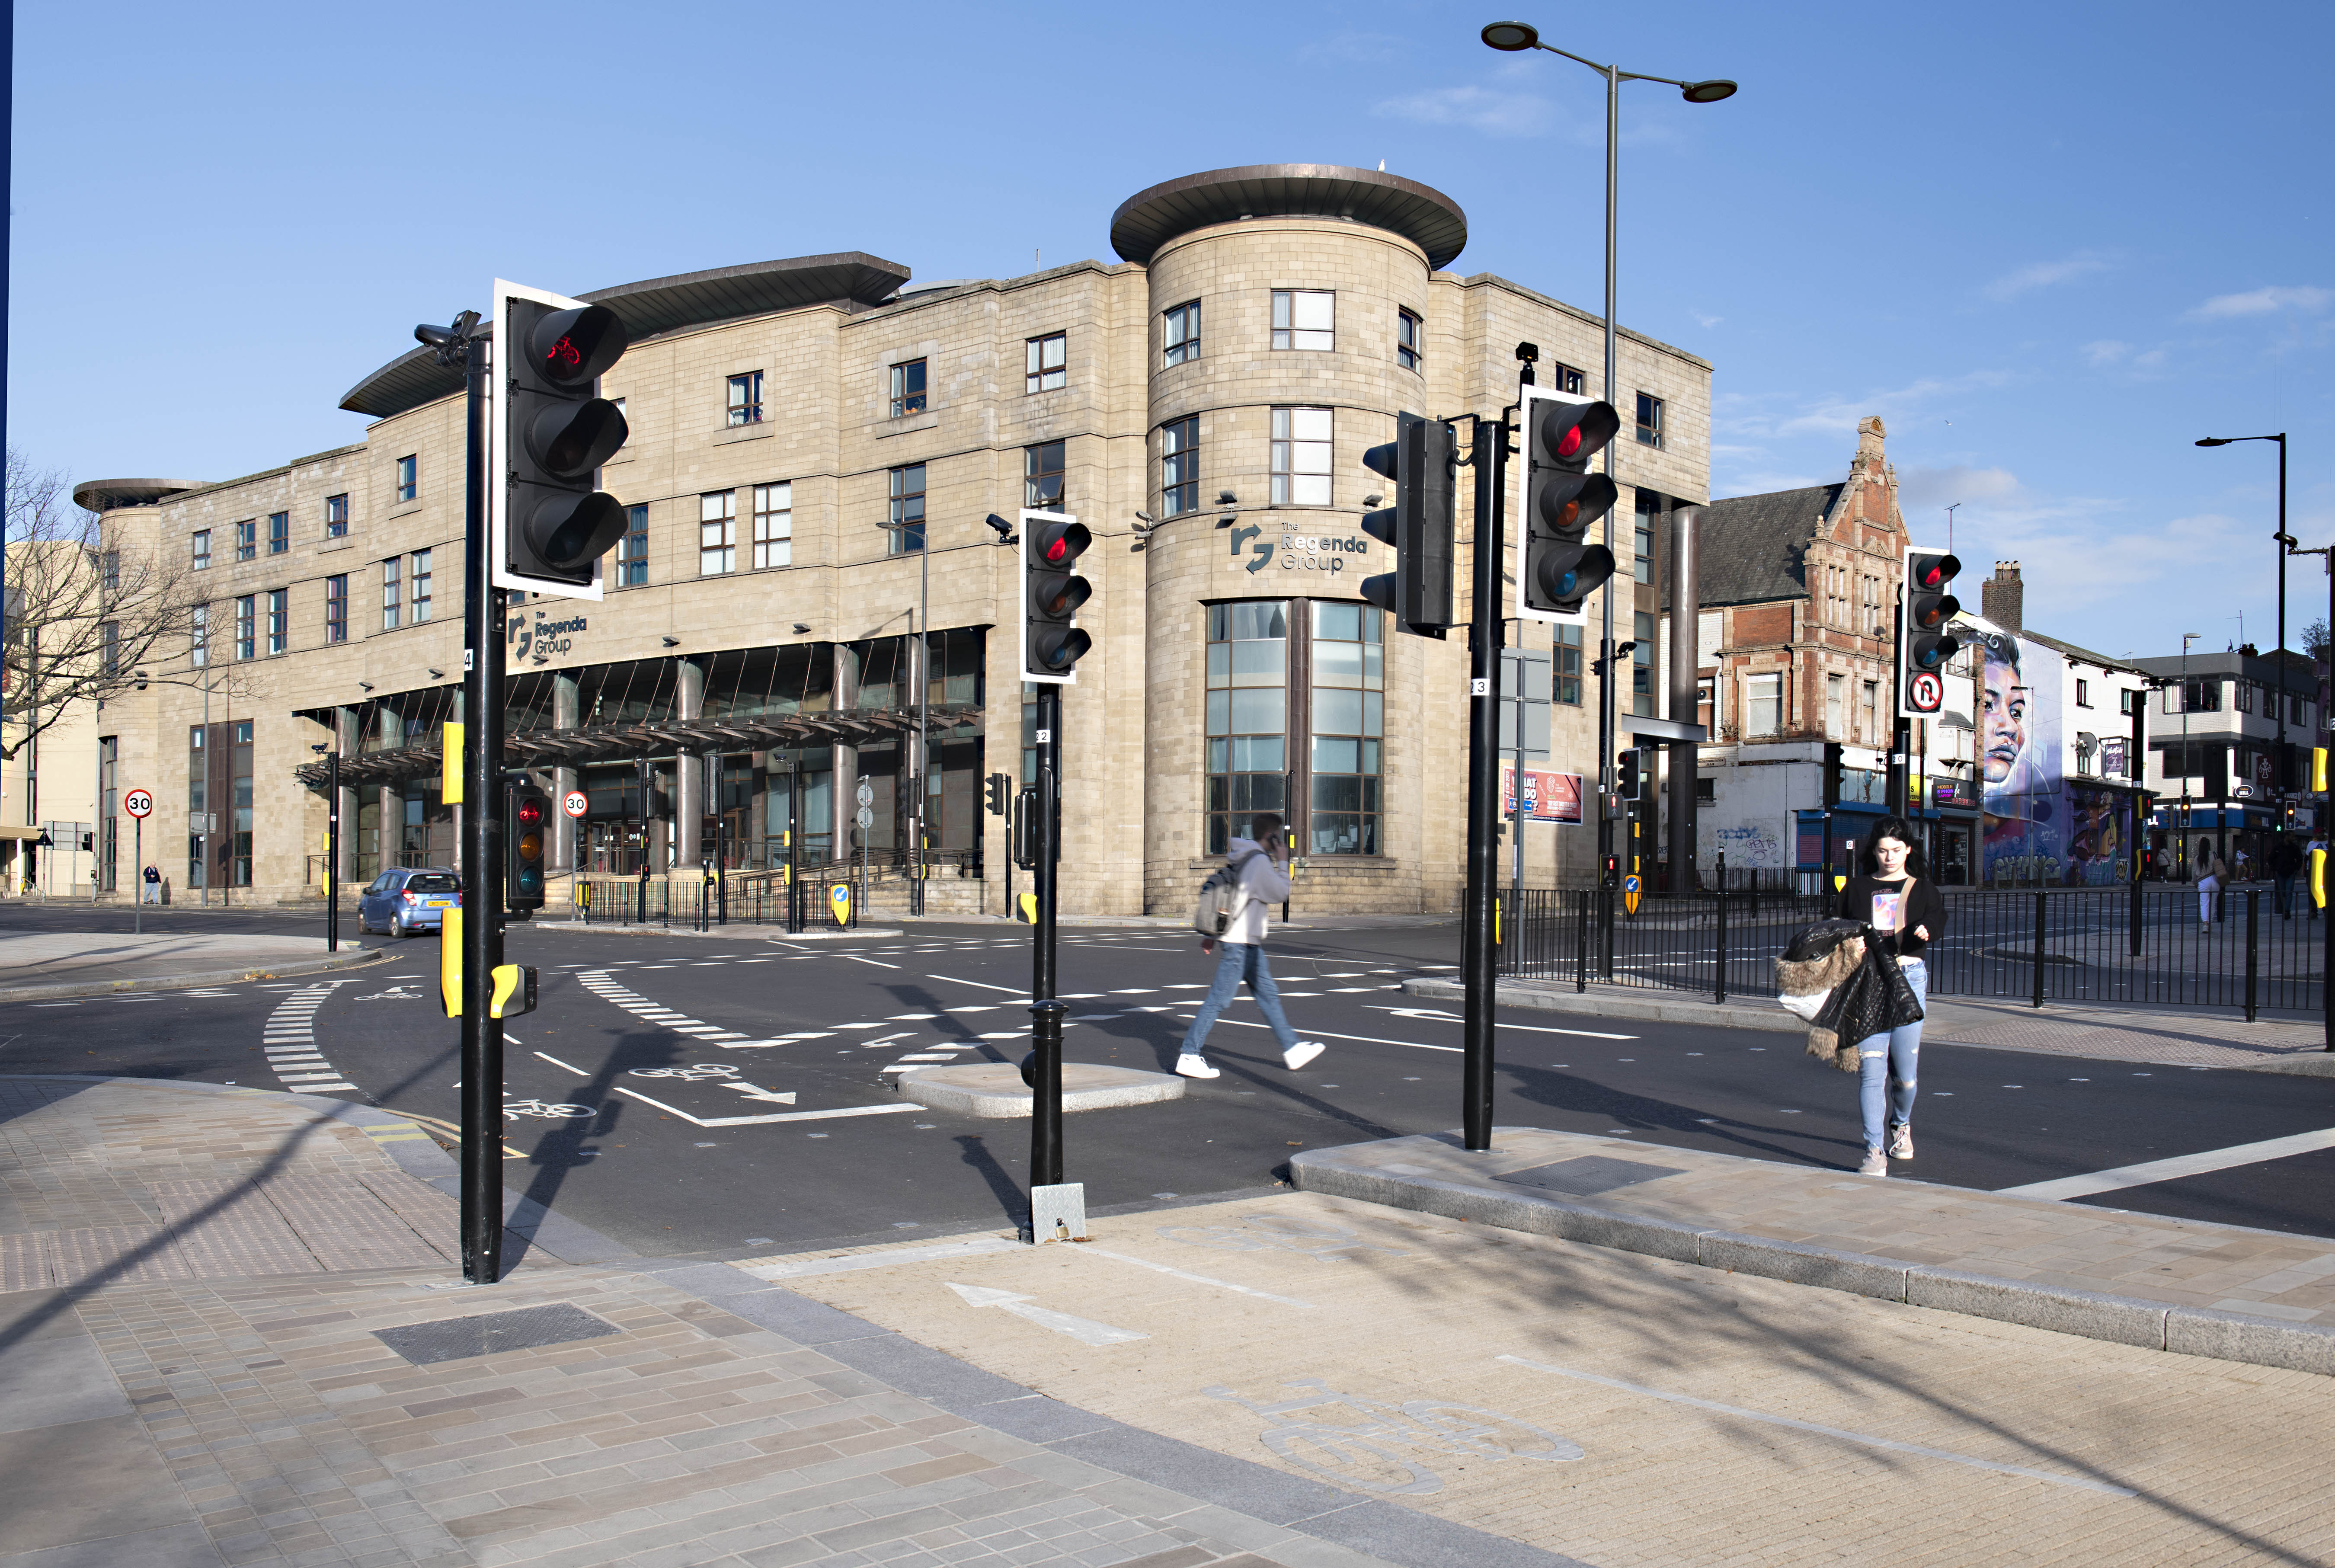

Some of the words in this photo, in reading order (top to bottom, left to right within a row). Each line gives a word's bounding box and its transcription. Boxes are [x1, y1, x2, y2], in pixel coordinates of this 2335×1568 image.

[1281, 522, 1299, 530] The
[1281, 534, 1367, 555] Regenda
[1281, 553, 1343, 576] Group
[536, 611, 546, 619] The
[535, 616, 587, 640] Regenda
[535, 638, 572, 656] Group
[130, 797, 150, 810] 30
[568, 799, 584, 809] 30
[1951, 798, 1976, 806] BARBERS
